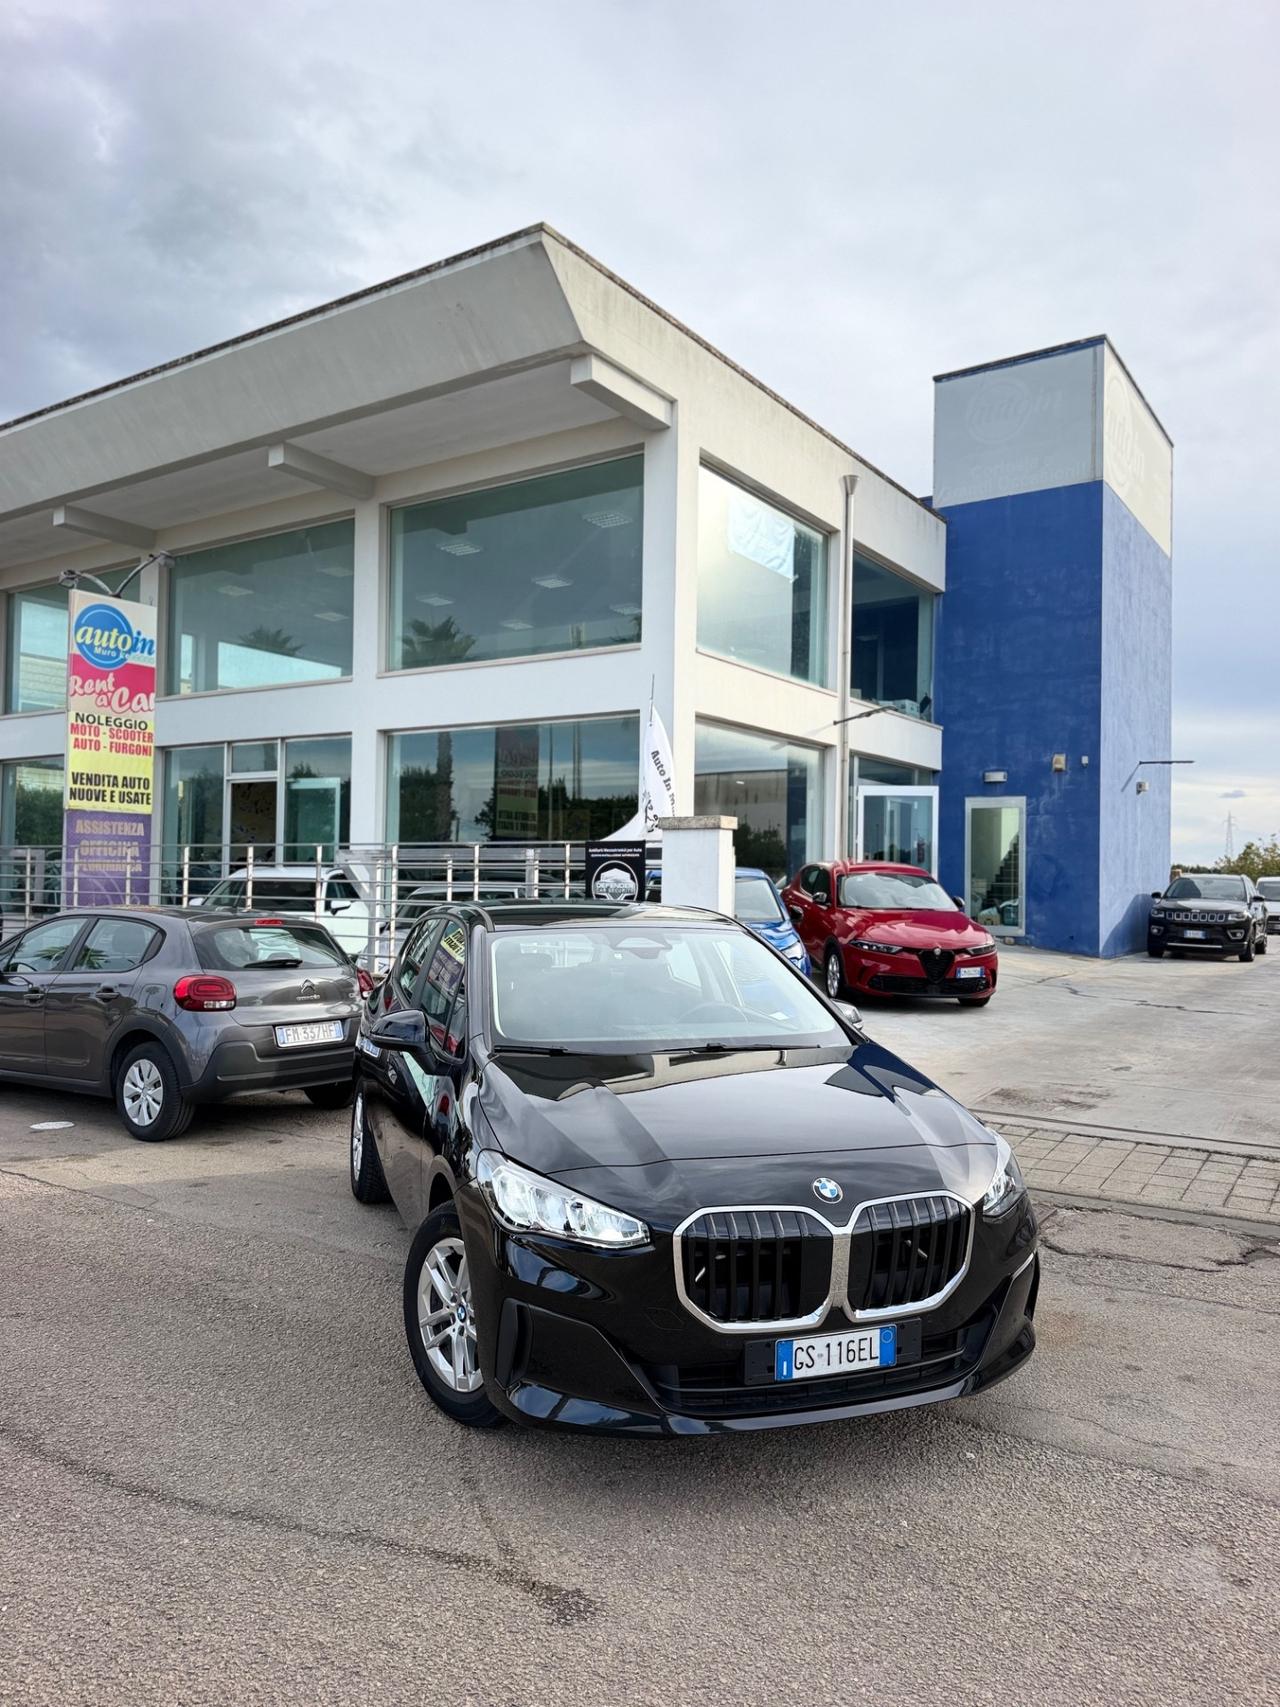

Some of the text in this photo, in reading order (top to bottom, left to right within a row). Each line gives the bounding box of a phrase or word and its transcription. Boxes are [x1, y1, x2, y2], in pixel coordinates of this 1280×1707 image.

[69, 672, 115, 697] Rent
[75, 712, 148, 731] NOLEGGIO
[70, 723, 101, 738] MOTO
[108, 728, 153, 743] SCOOTER
[73, 738, 101, 752] AUTO
[109, 741, 152, 757] FURGONI
[650, 749, 667, 777] Auto
[71, 771, 150, 791] VENDITA AUTO
[69, 787, 152, 806] NUOVE E USATE
[75, 819, 145, 837] ASSISTENZA
